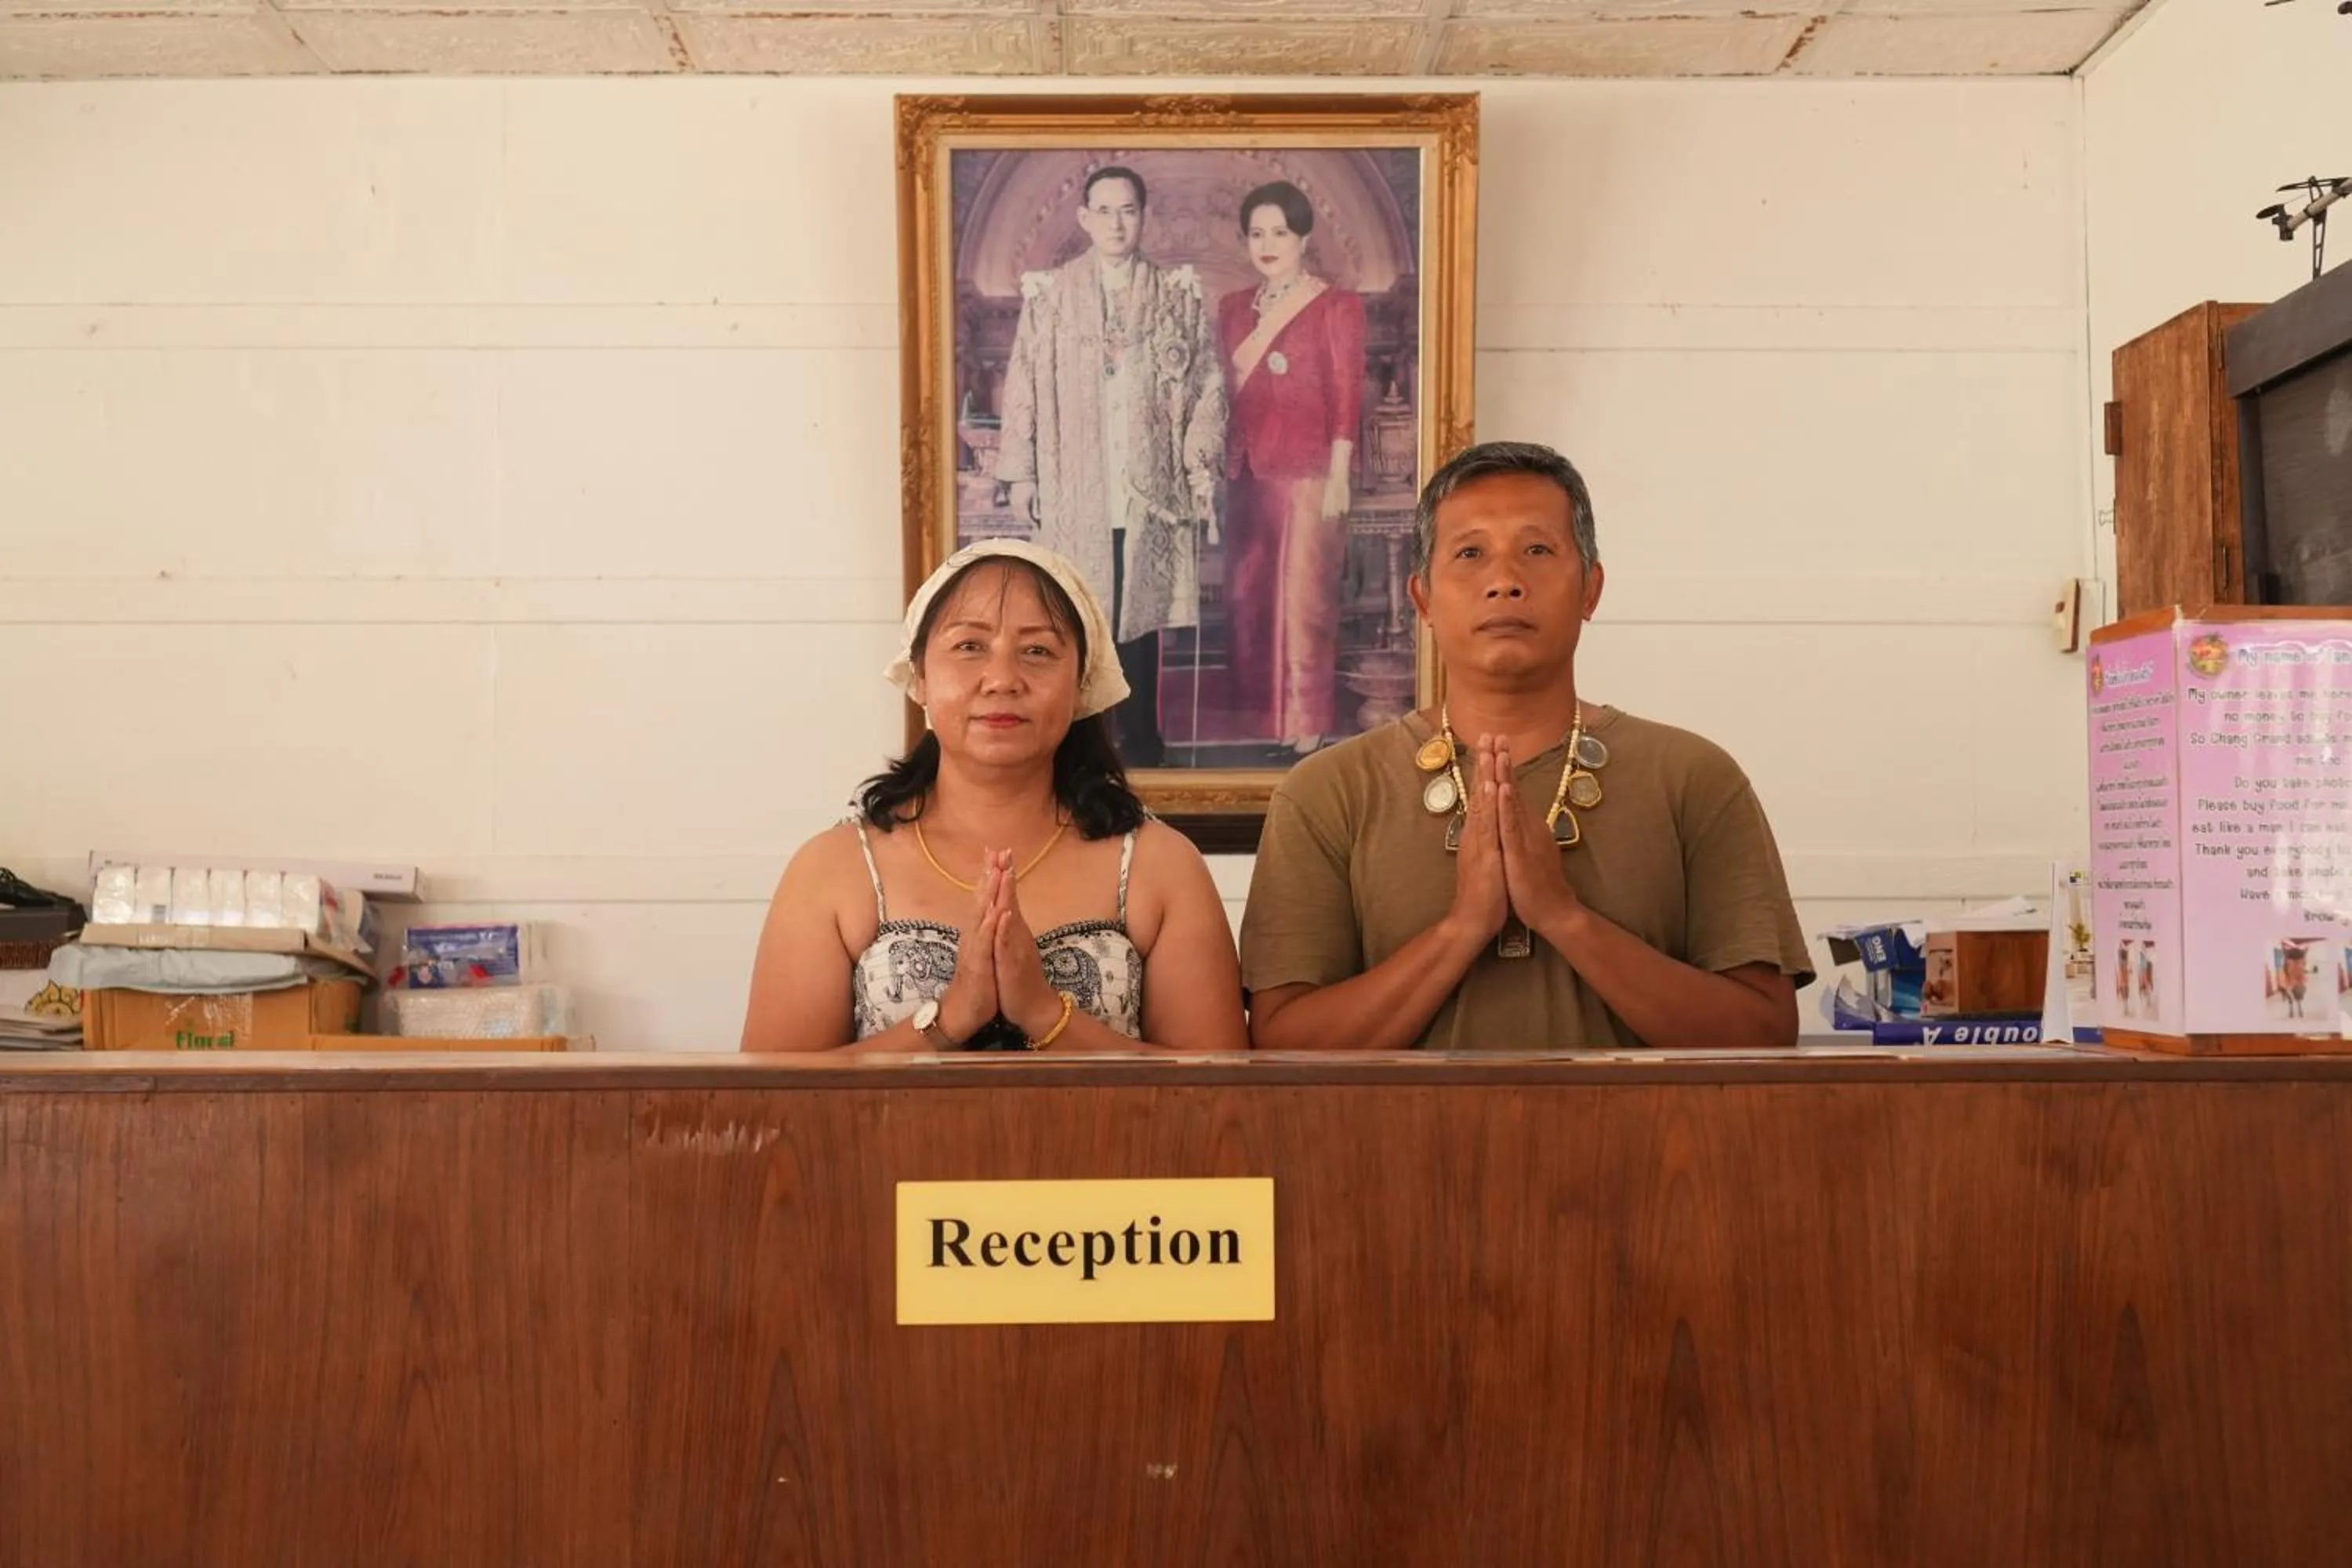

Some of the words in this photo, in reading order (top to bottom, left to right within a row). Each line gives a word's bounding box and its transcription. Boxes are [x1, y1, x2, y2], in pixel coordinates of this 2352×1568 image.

[2188, 688, 2205, 704] My
[2224, 712, 2239, 721] no
[2290, 711, 2304, 721] to
[2190, 732, 2205, 744] So
[2234, 776, 2249, 788] Do
[2256, 779, 2277, 792] you
[2198, 799, 2237, 811] Please
[2243, 800, 2265, 815] buy
[2270, 798, 2299, 811] food
[2192, 822, 2214, 833] eat
[2220, 822, 2241, 833] like
[2247, 824, 2254, 833] a
[2194, 843, 2230, 855] Thank
[2237, 845, 2259, 860] you
[1954, 1025, 2038, 1046] ouble
[926, 1215, 1242, 1280] Reception
